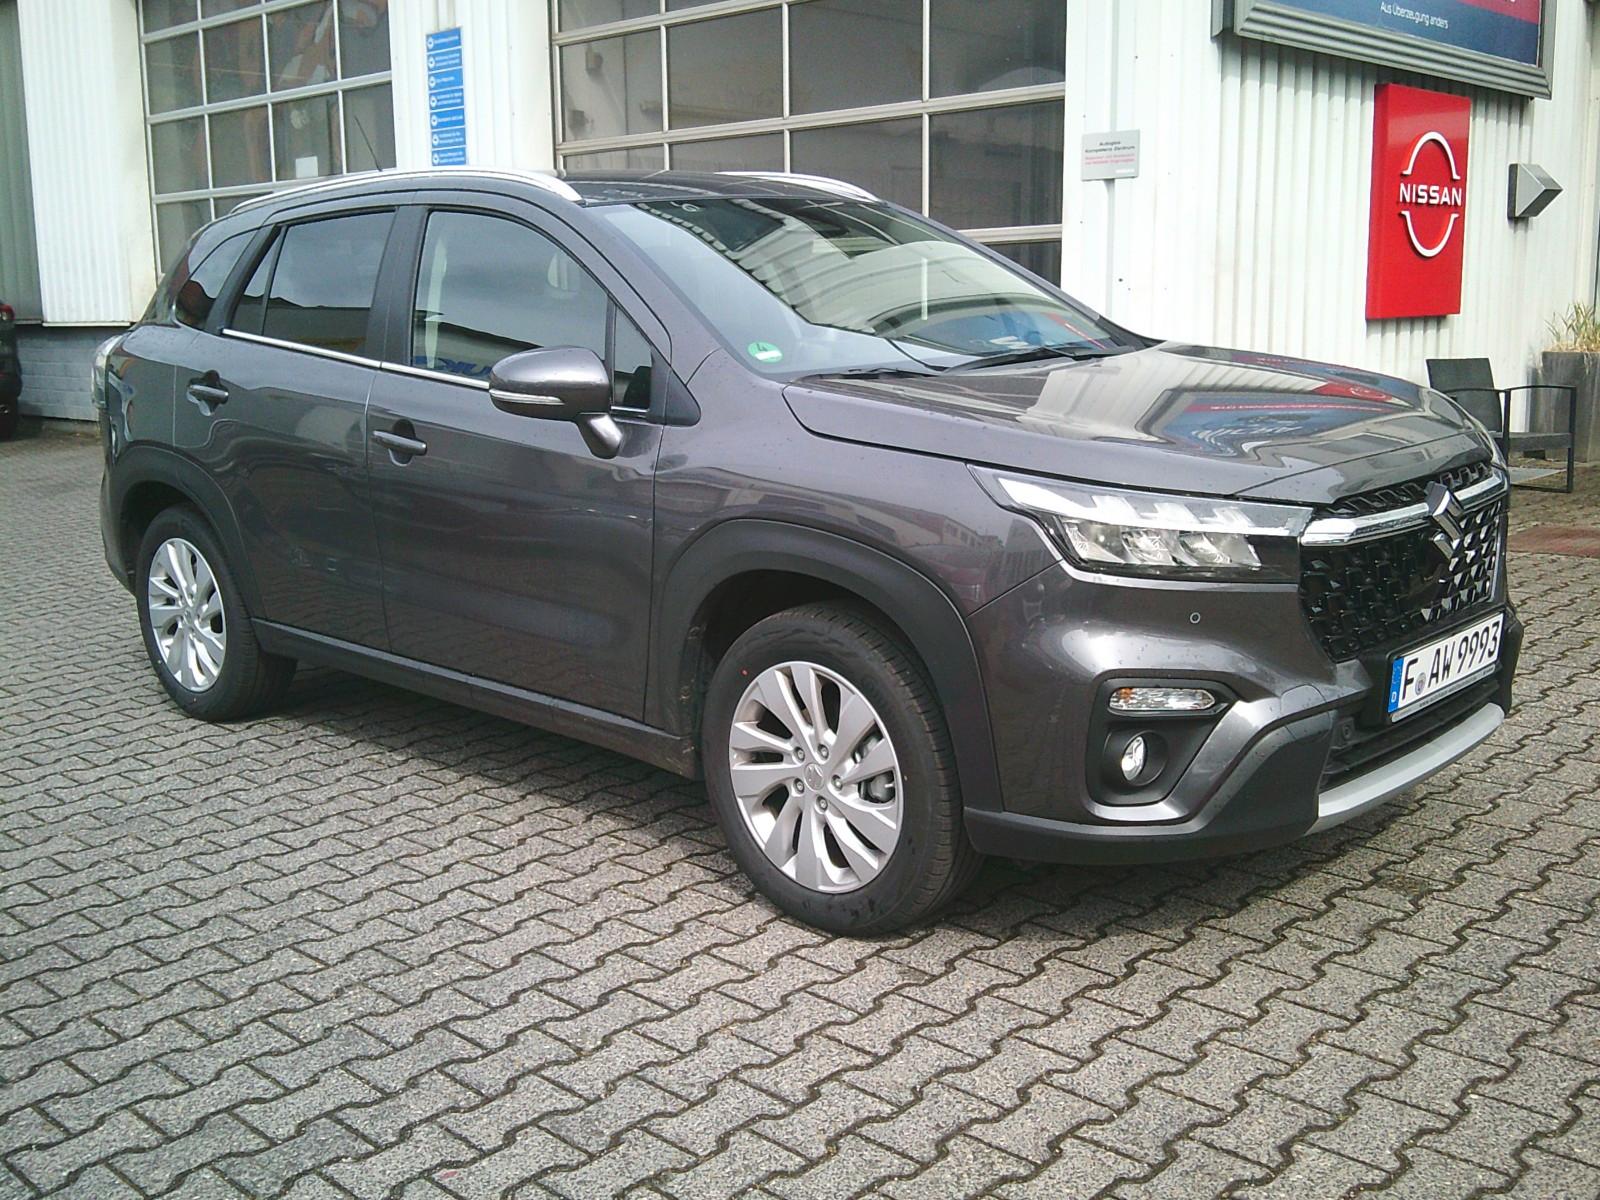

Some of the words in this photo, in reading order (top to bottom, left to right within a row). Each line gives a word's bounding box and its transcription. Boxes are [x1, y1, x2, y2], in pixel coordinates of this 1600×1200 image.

[1380, 2, 1392, 14] Aus
[1430, 15, 1449, 29] anders
[1400, 182, 1462, 206] NISSAN
[1402, 657, 1419, 701] F
[1457, 620, 1500, 674] 9993
